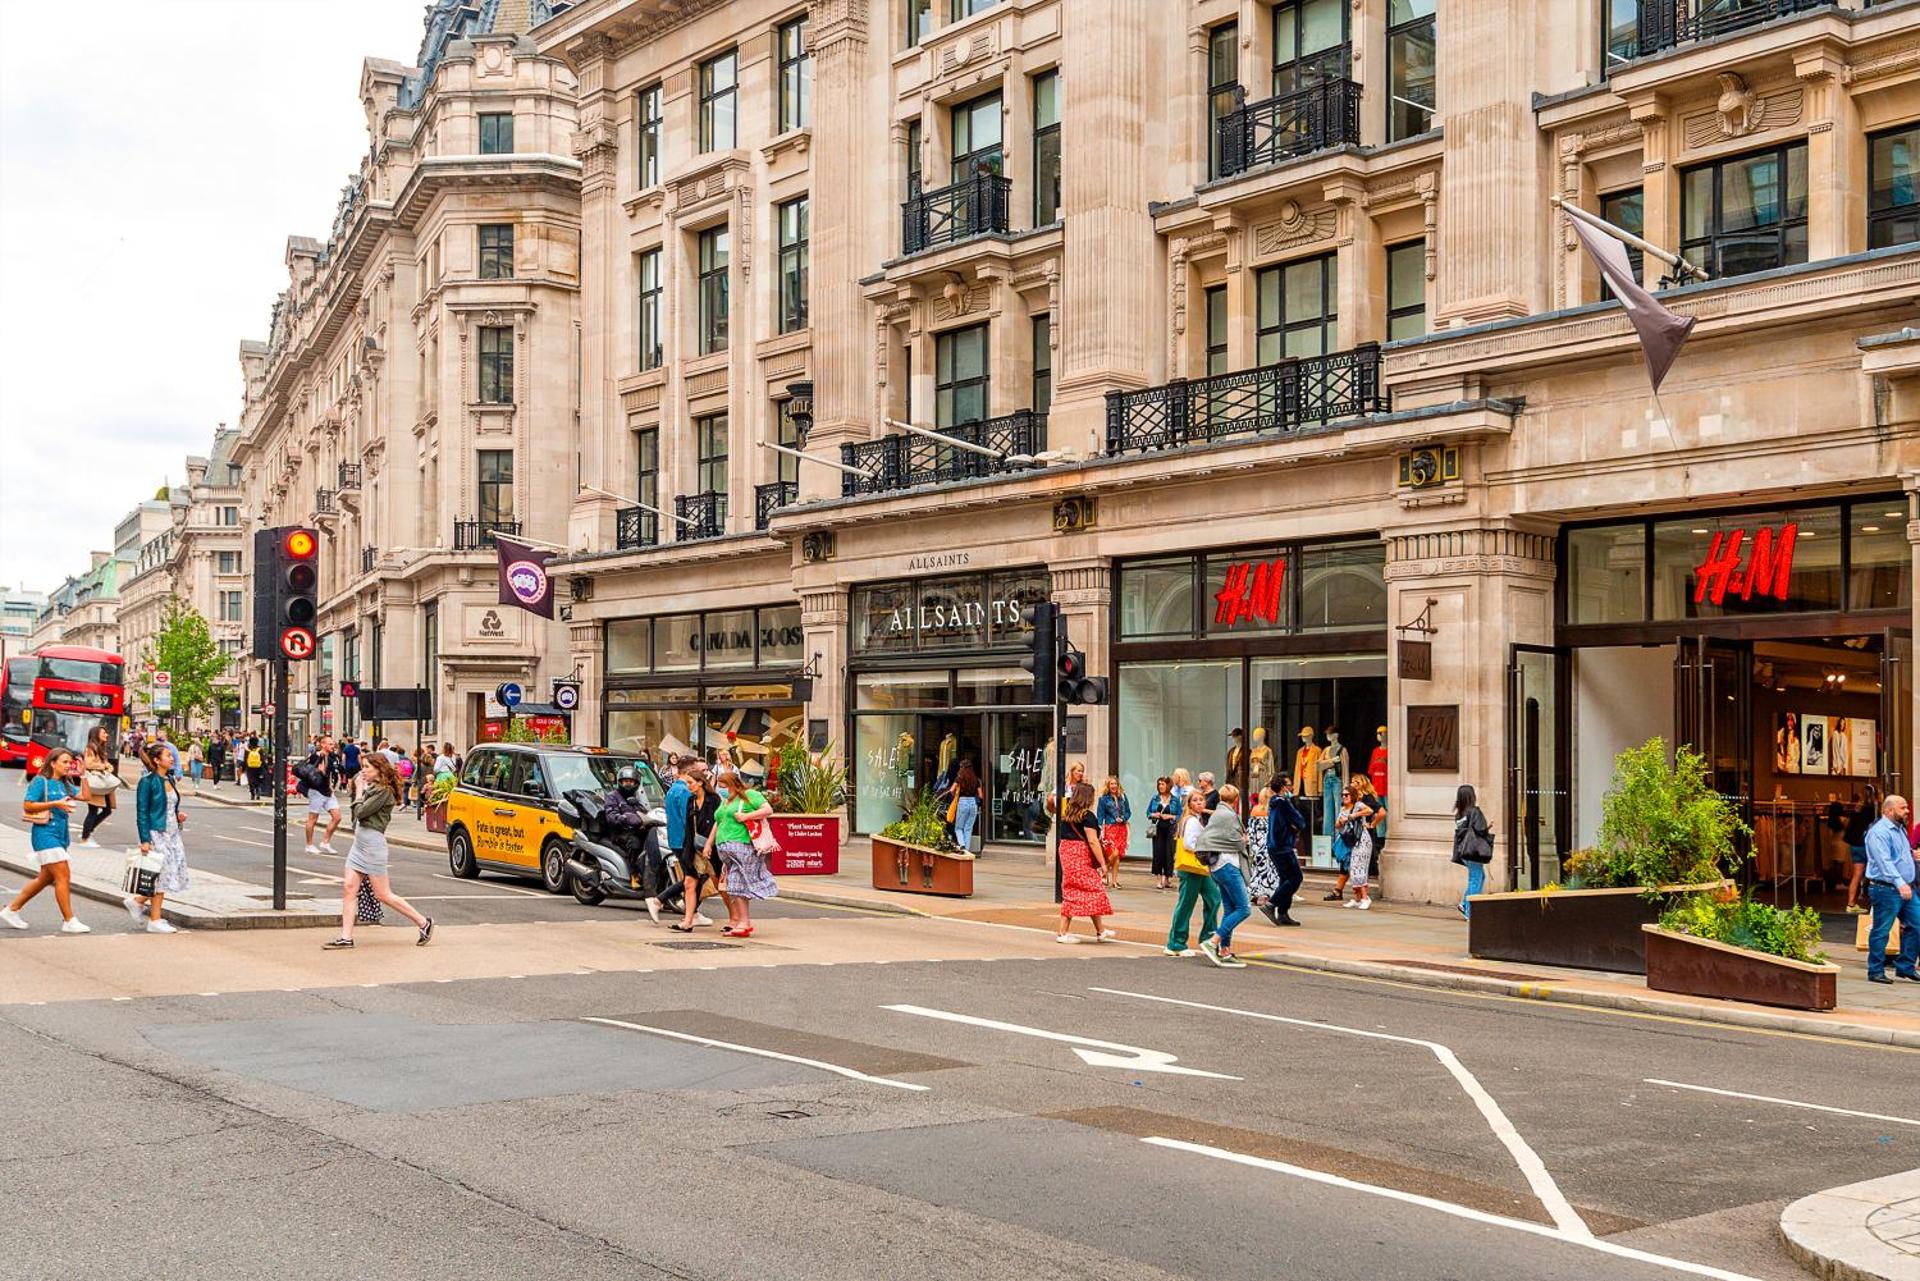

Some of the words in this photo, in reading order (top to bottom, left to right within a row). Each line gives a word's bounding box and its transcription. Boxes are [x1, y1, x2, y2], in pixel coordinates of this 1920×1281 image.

[908, 552, 970, 571] ALLSAINTS
[1693, 522, 1798, 606] H&M
[1215, 559, 1286, 625] H&M
[479, 629, 504, 637] NatWest
[867, 747, 897, 769] SALE
[1008, 747, 1043, 772] SALE
[476, 820, 489, 833] Fate
